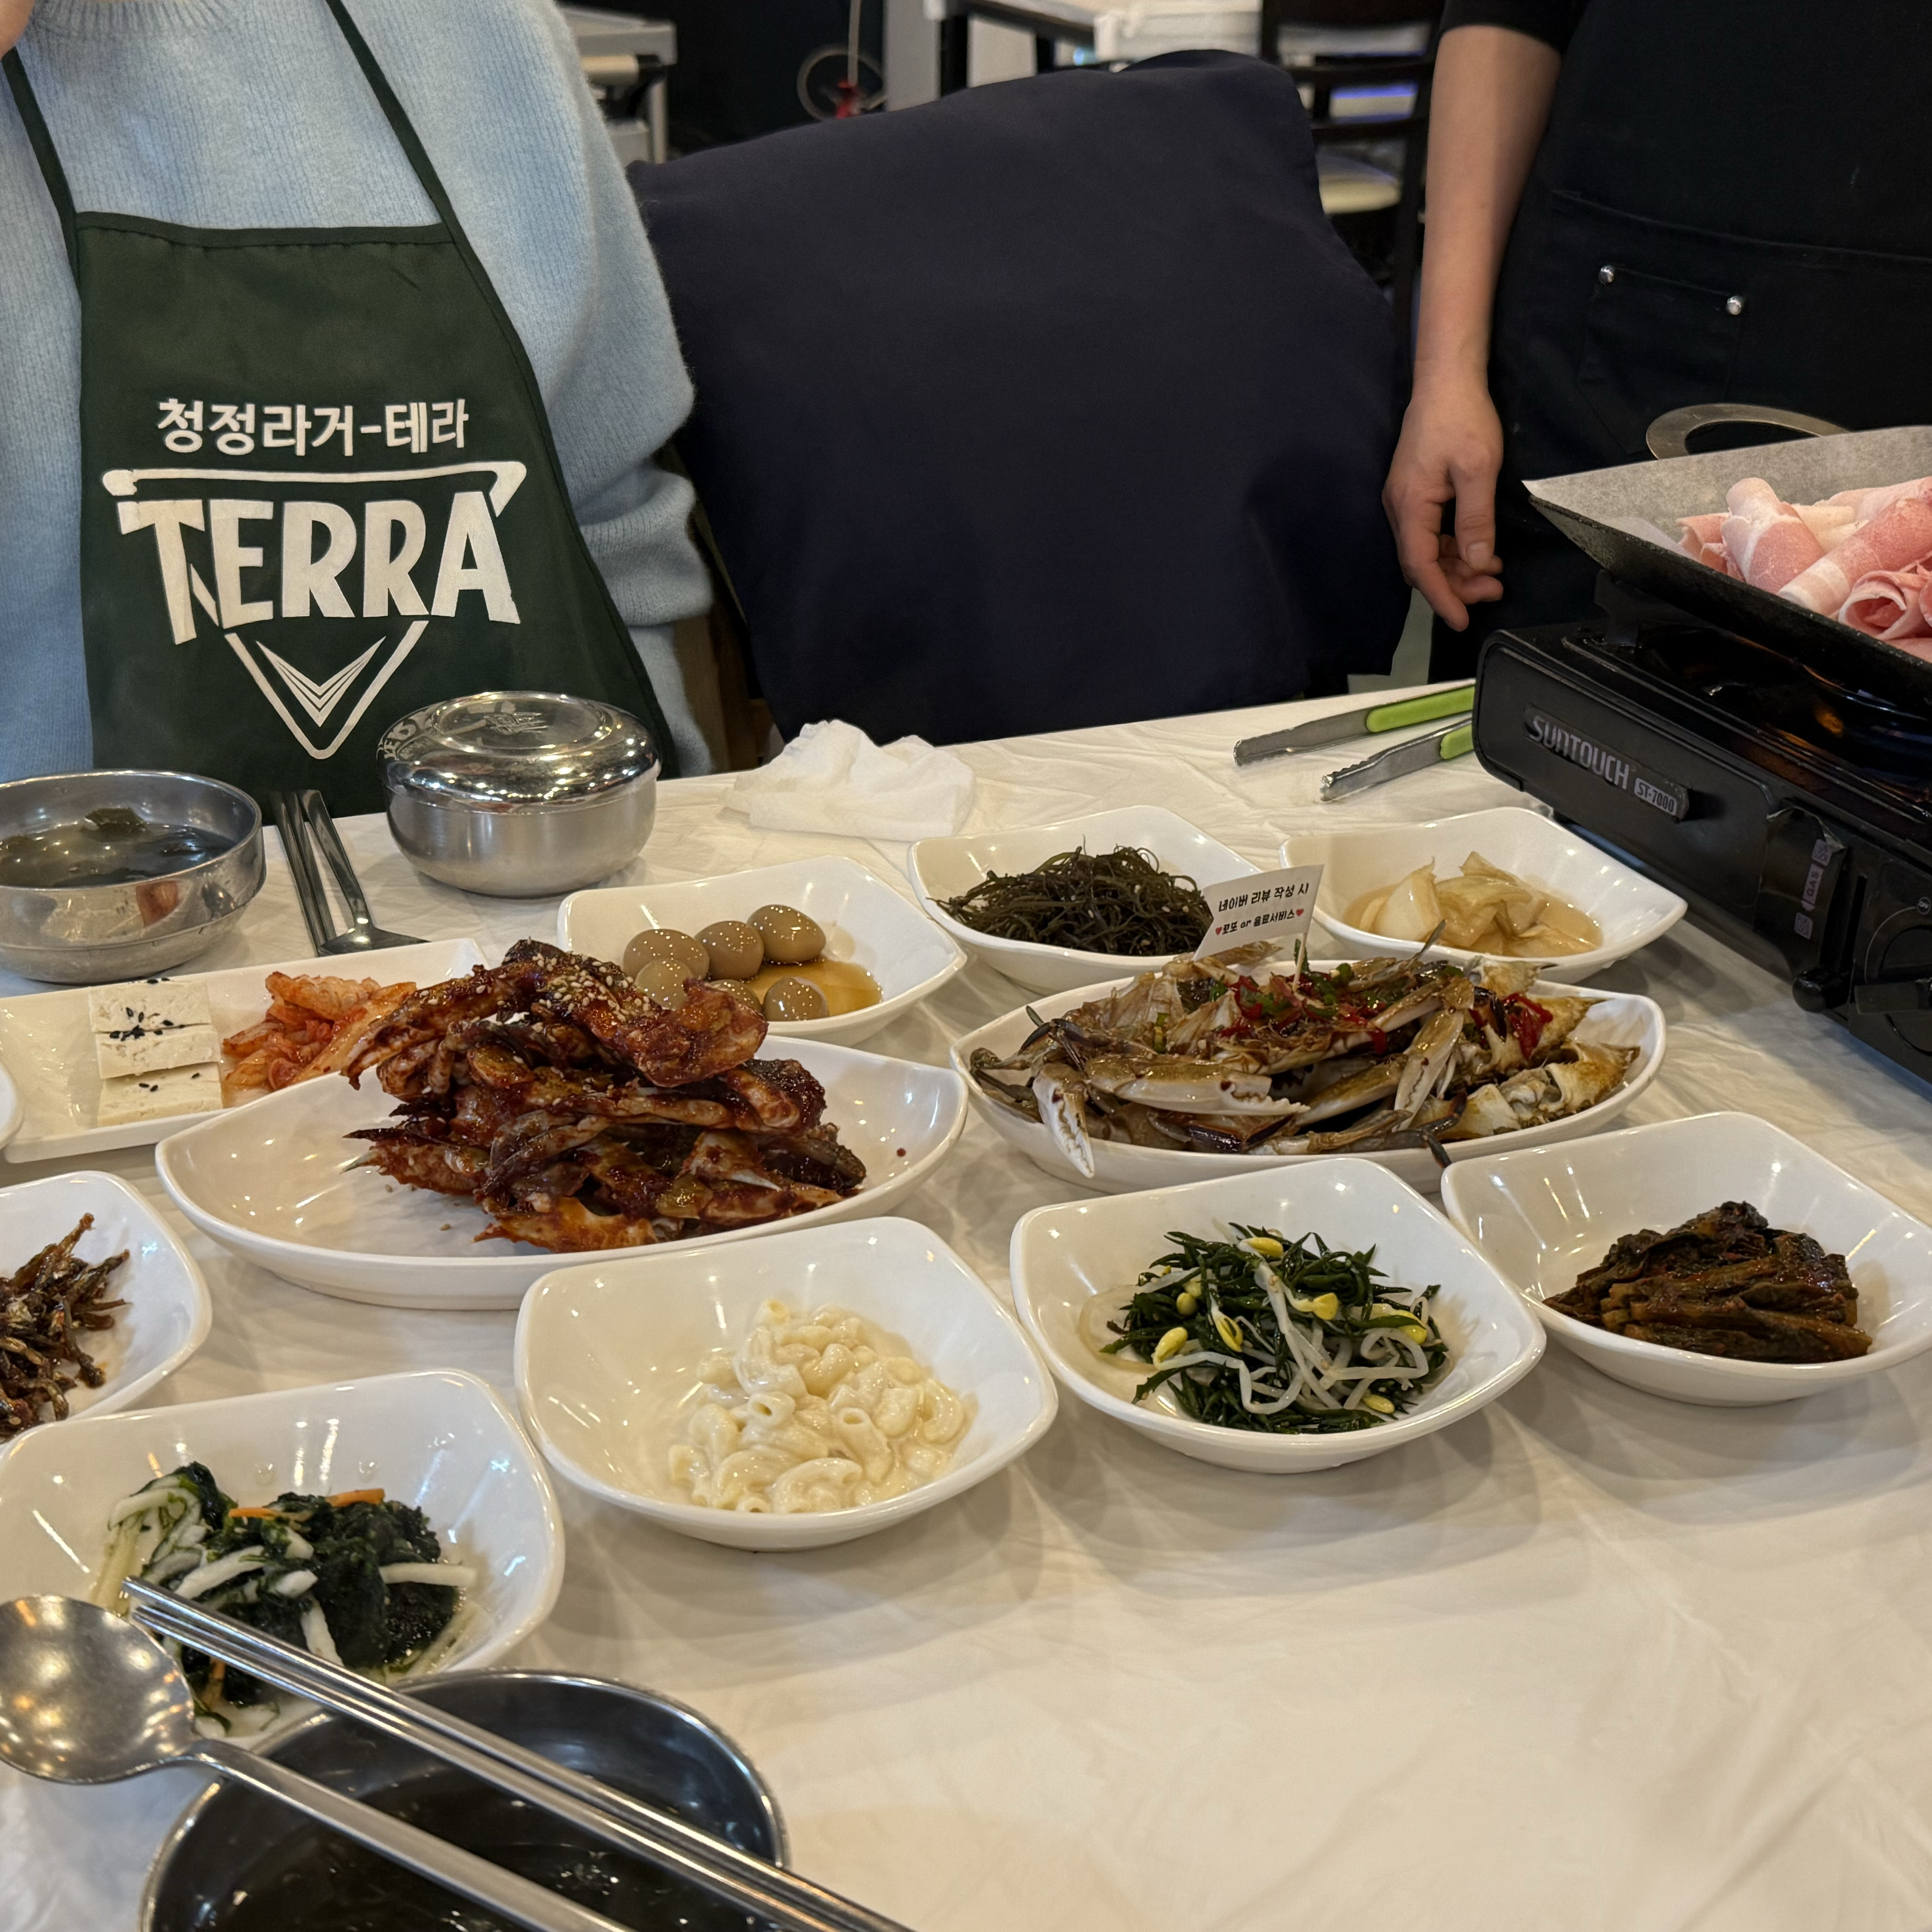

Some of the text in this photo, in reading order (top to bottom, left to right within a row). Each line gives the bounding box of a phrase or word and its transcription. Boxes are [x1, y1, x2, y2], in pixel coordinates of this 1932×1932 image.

[156, 398, 469, 455] 청정라거-테라
[116, 491, 521, 645] TERRA
[1636, 783, 1675, 813] ST-7000
[1218, 882, 1309, 912] 네이버 리뷰 작성 시
[1807, 870, 1819, 897] GAS
[1240, 920, 1251, 929] or
